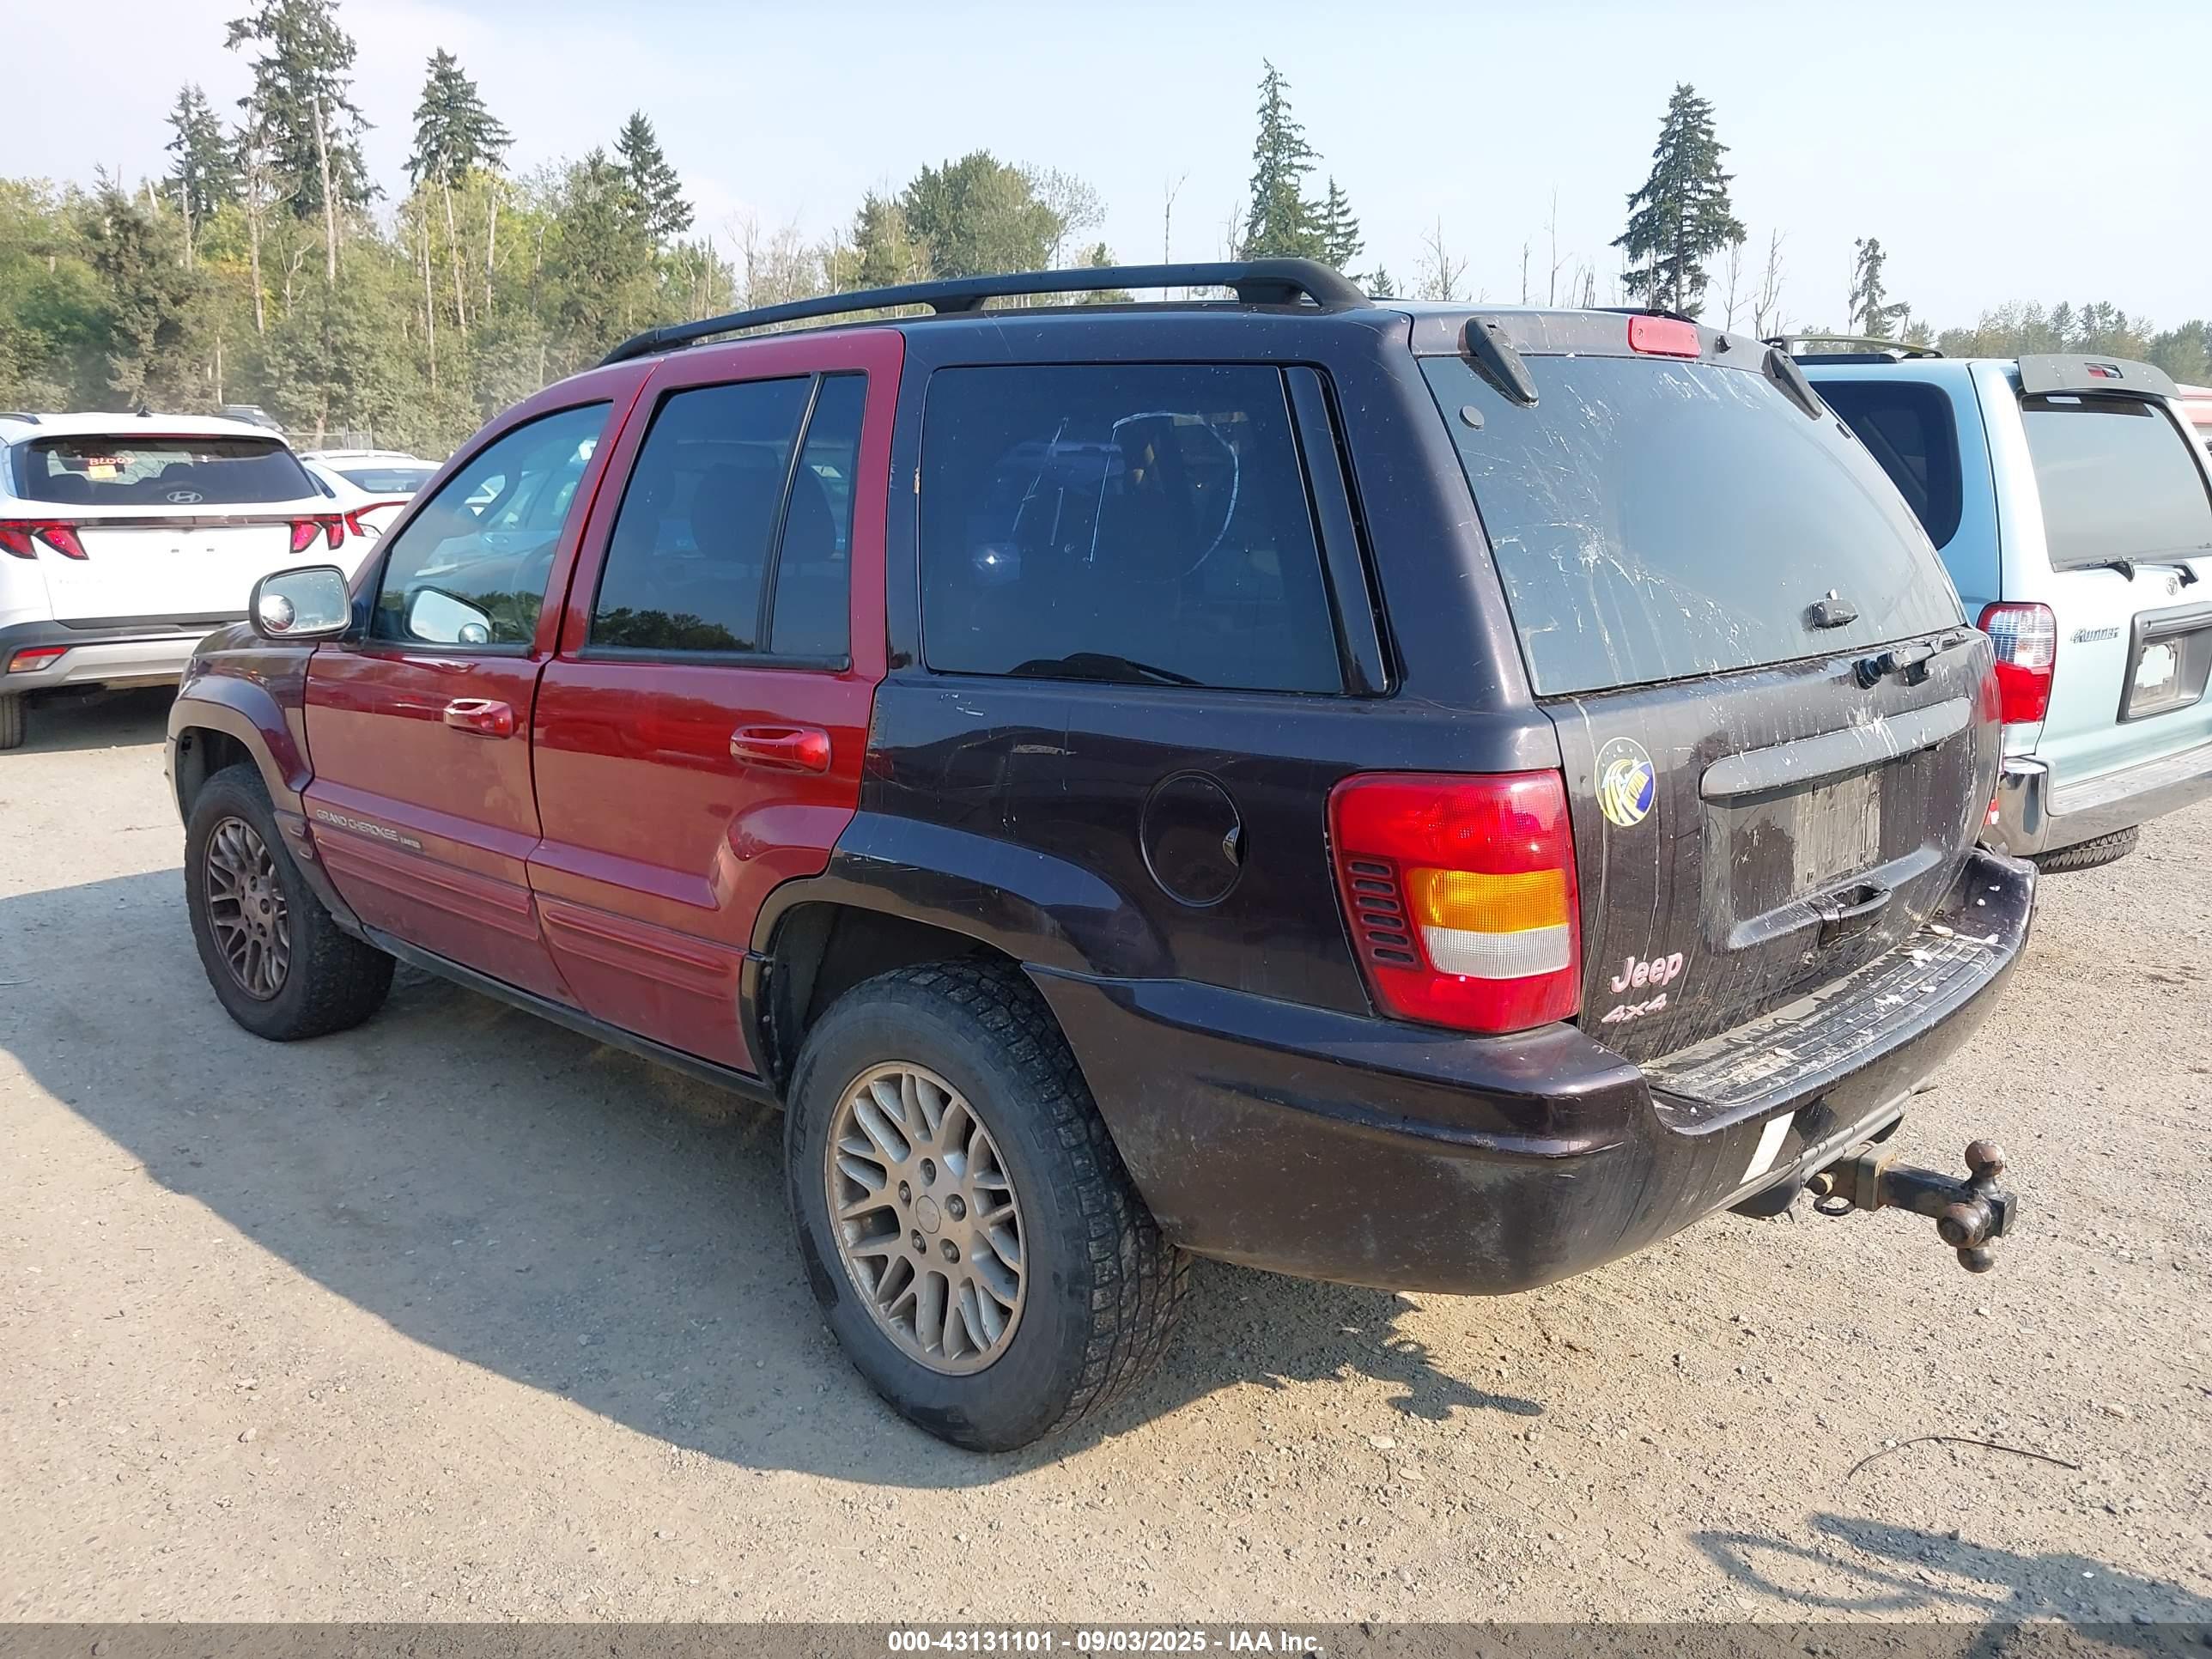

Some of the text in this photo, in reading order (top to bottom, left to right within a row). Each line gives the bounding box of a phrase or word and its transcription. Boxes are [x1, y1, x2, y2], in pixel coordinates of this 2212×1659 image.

[316, 809, 347, 826] GRAND
[348, 818, 398, 842] CHEROKEE
[1611, 952, 1683, 993] Jeep
